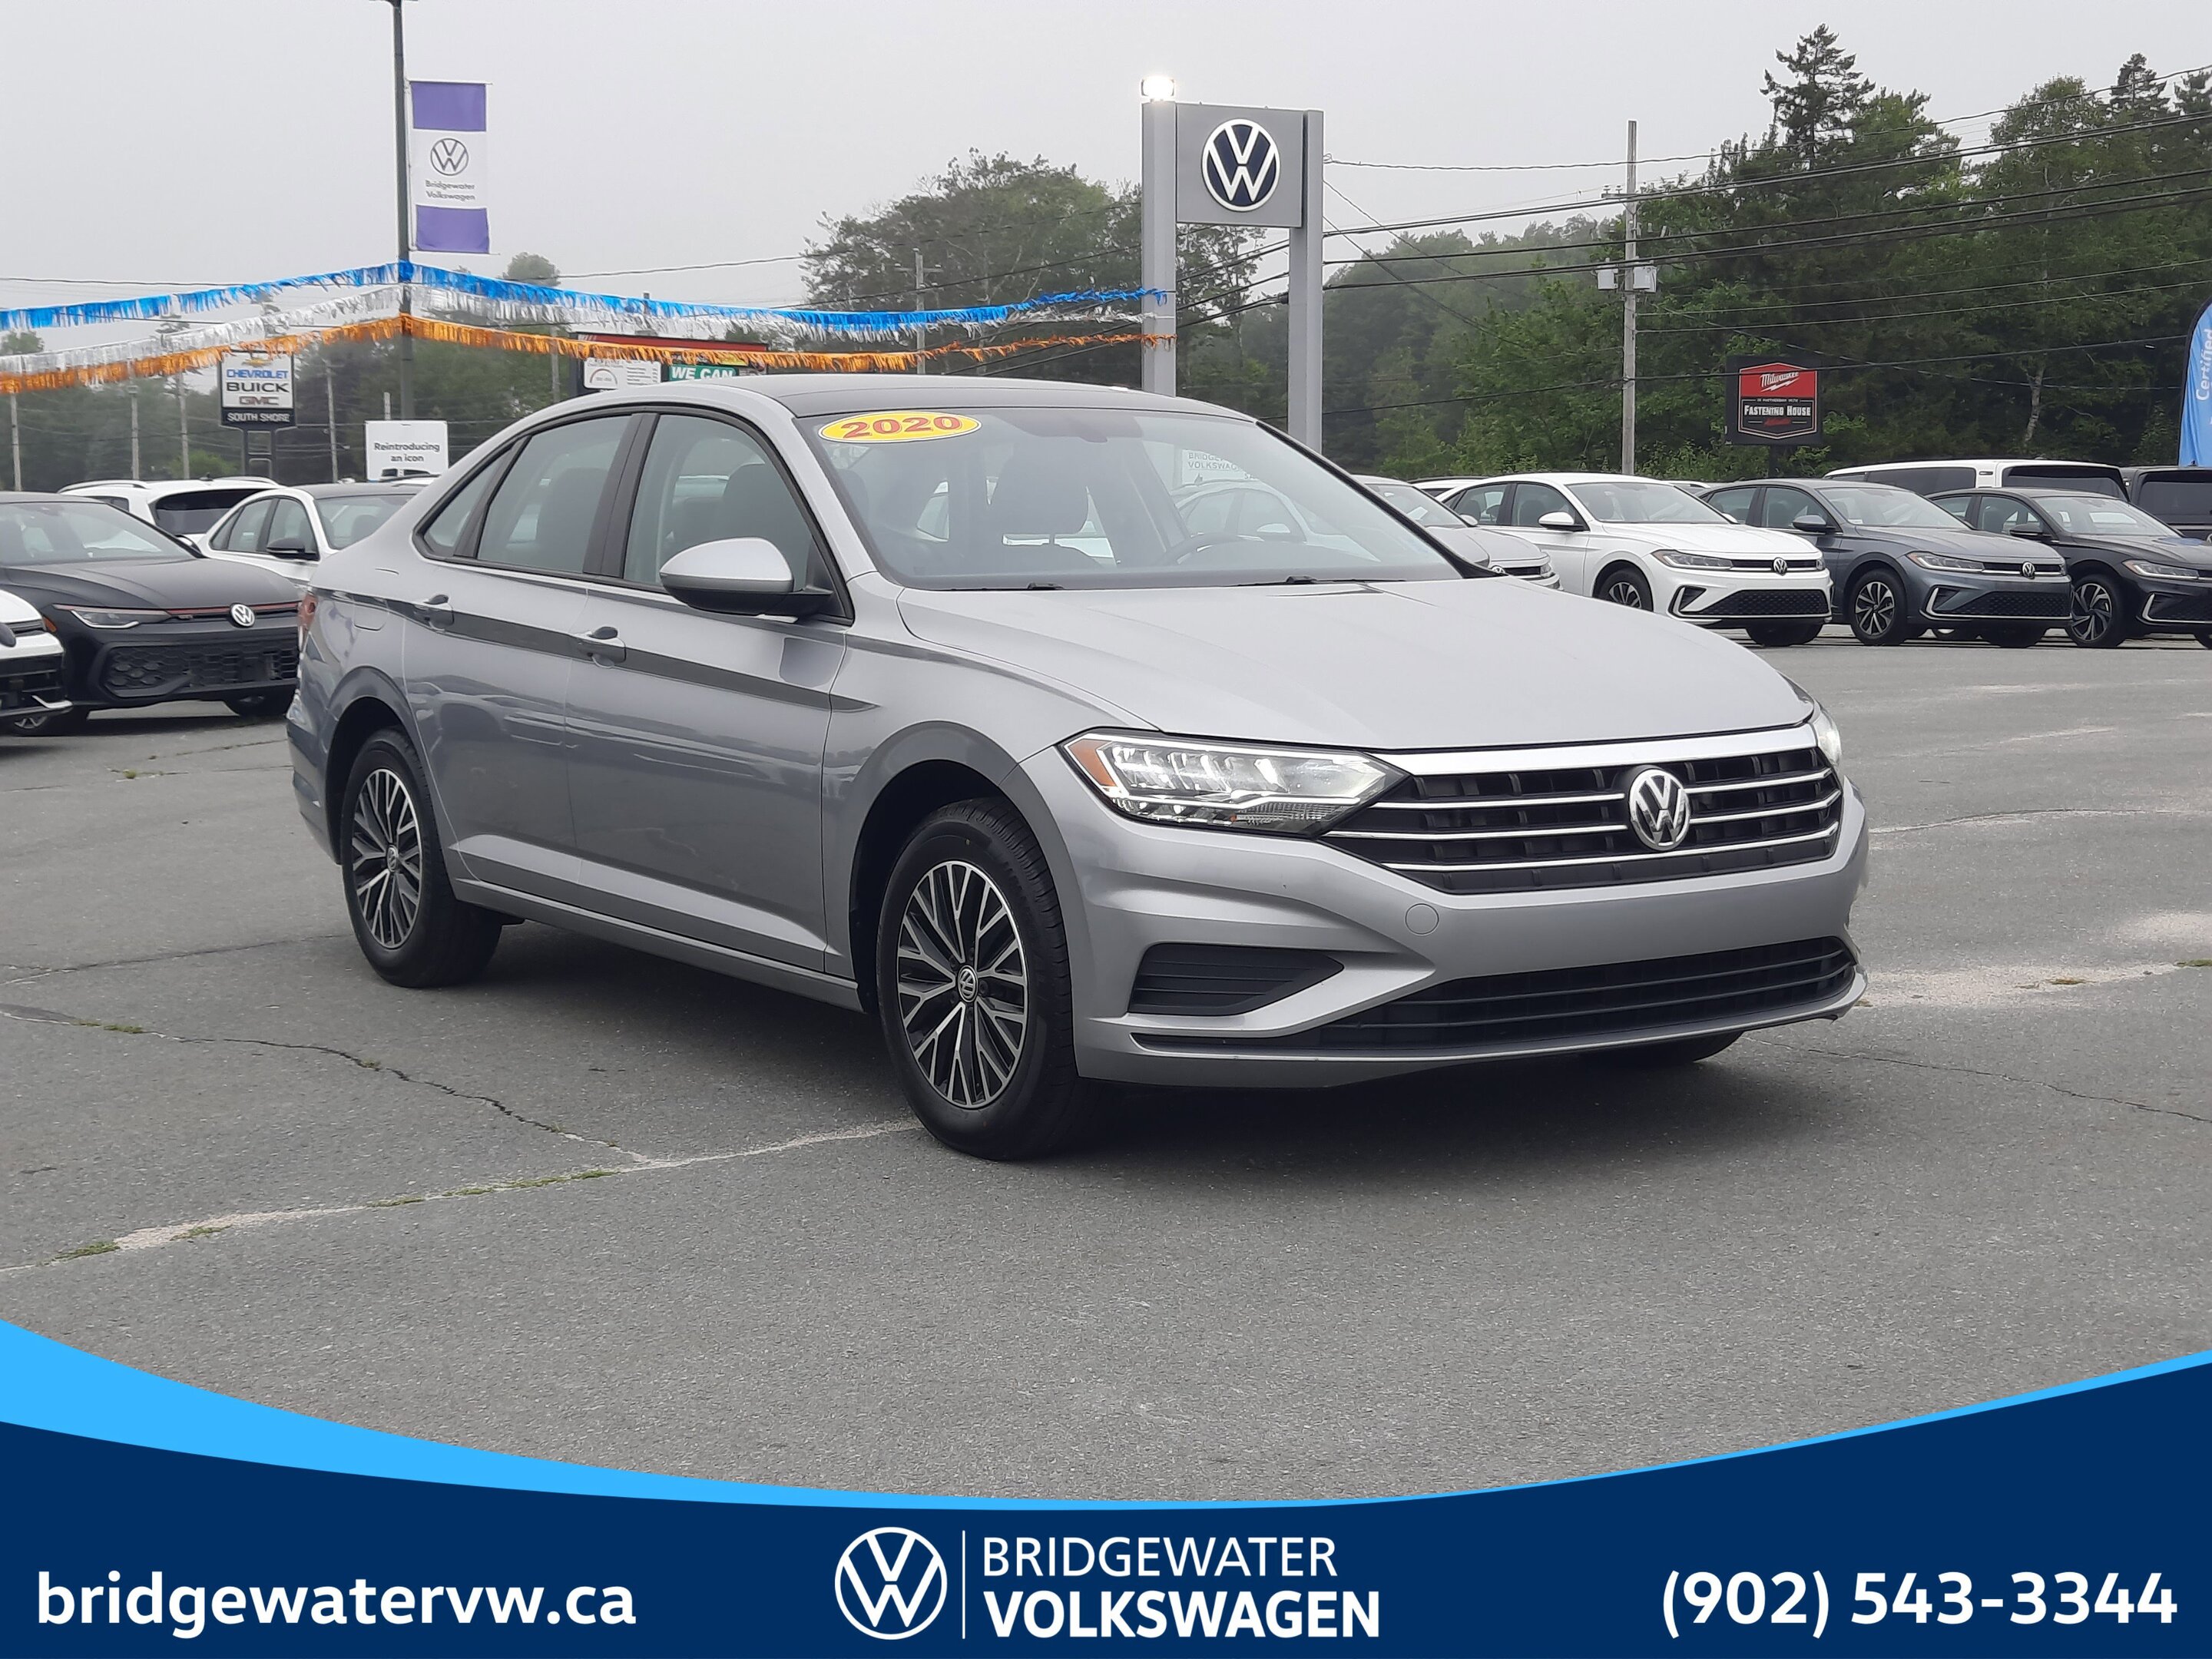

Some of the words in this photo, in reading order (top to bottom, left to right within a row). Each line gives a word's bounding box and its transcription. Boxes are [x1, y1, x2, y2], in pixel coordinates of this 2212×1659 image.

[426, 180, 475, 190] Bridgewater
[426, 190, 475, 201] Volkswagen
[2196, 329, 2212, 401] Certified
[227, 369, 289, 378] CHEVROLET
[671, 366, 696, 379] WE
[700, 368, 733, 379] CAN
[227, 382, 290, 392] BUICK
[239, 396, 280, 406] GMC
[1744, 405, 1784, 416] FASTENING
[1786, 405, 1811, 416] HOUSE
[227, 412, 258, 422] SOUTH
[260, 412, 290, 422] SHORE
[841, 416, 963, 439] 2020
[374, 442, 440, 452] Reintroducing
[404, 453, 424, 462] icon
